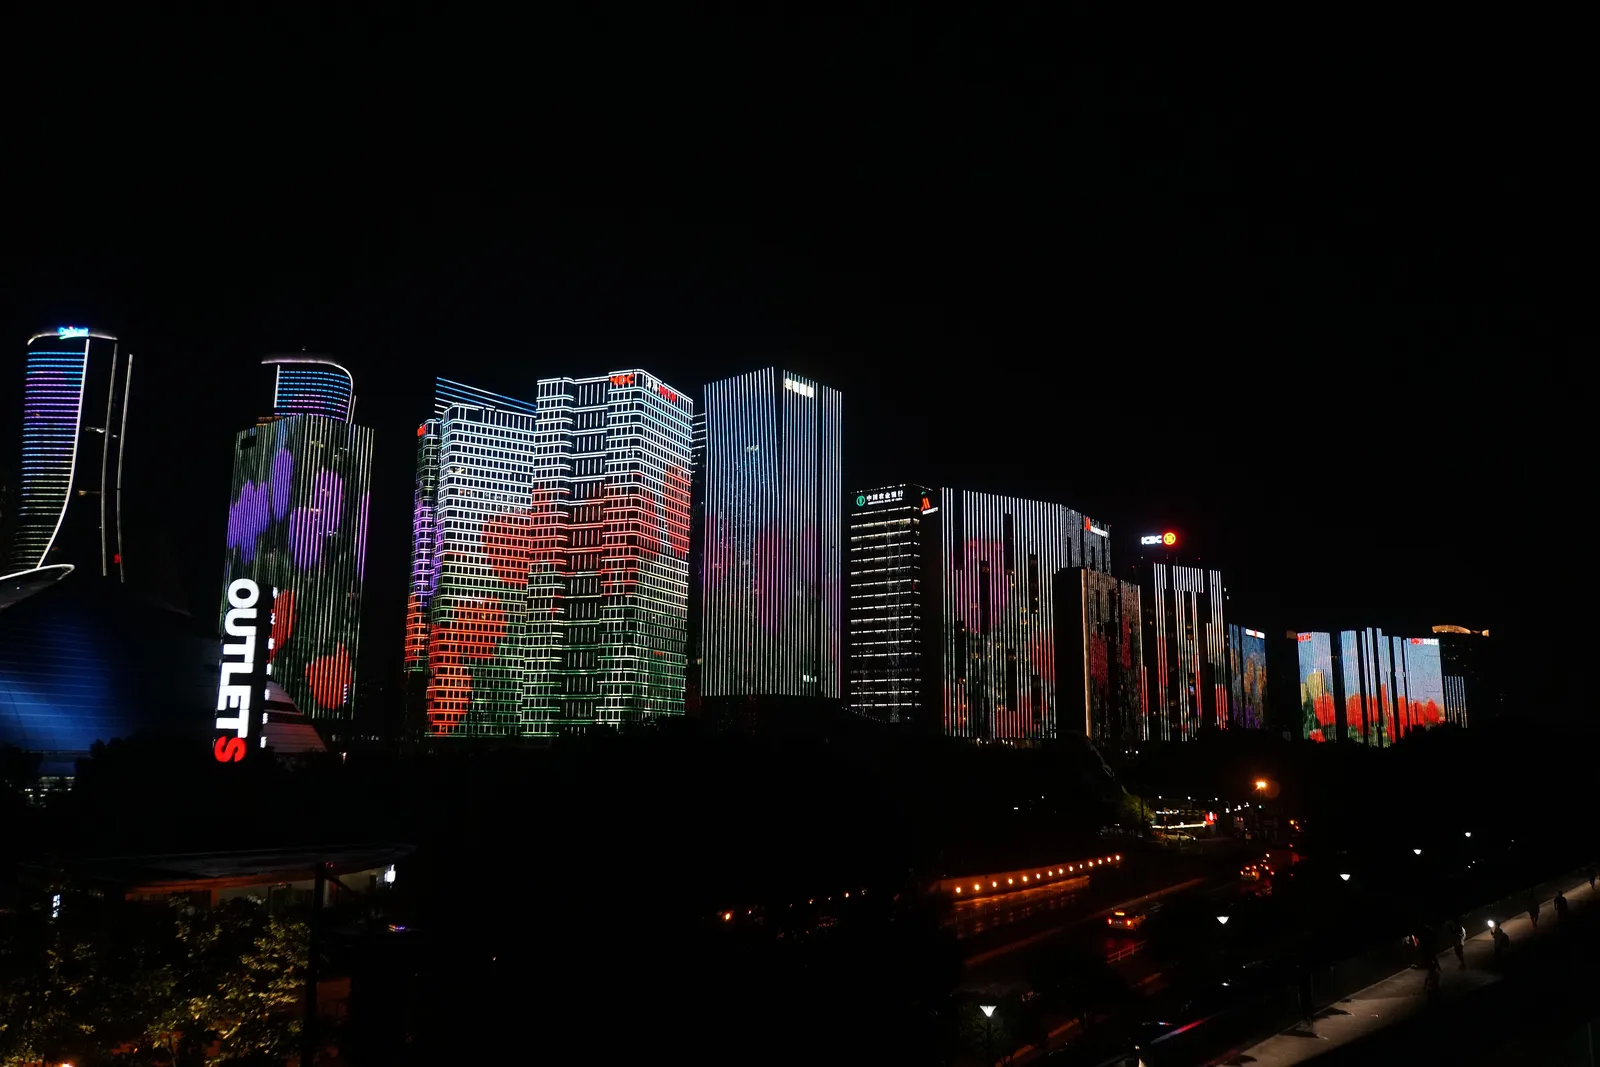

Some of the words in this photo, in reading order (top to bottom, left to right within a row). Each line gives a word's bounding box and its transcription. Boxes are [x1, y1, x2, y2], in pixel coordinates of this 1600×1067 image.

[866, 490, 903, 501] 中国农业银行
[1141, 535, 1162, 545] ICBC
[214, 578, 260, 763] OUTLETS
